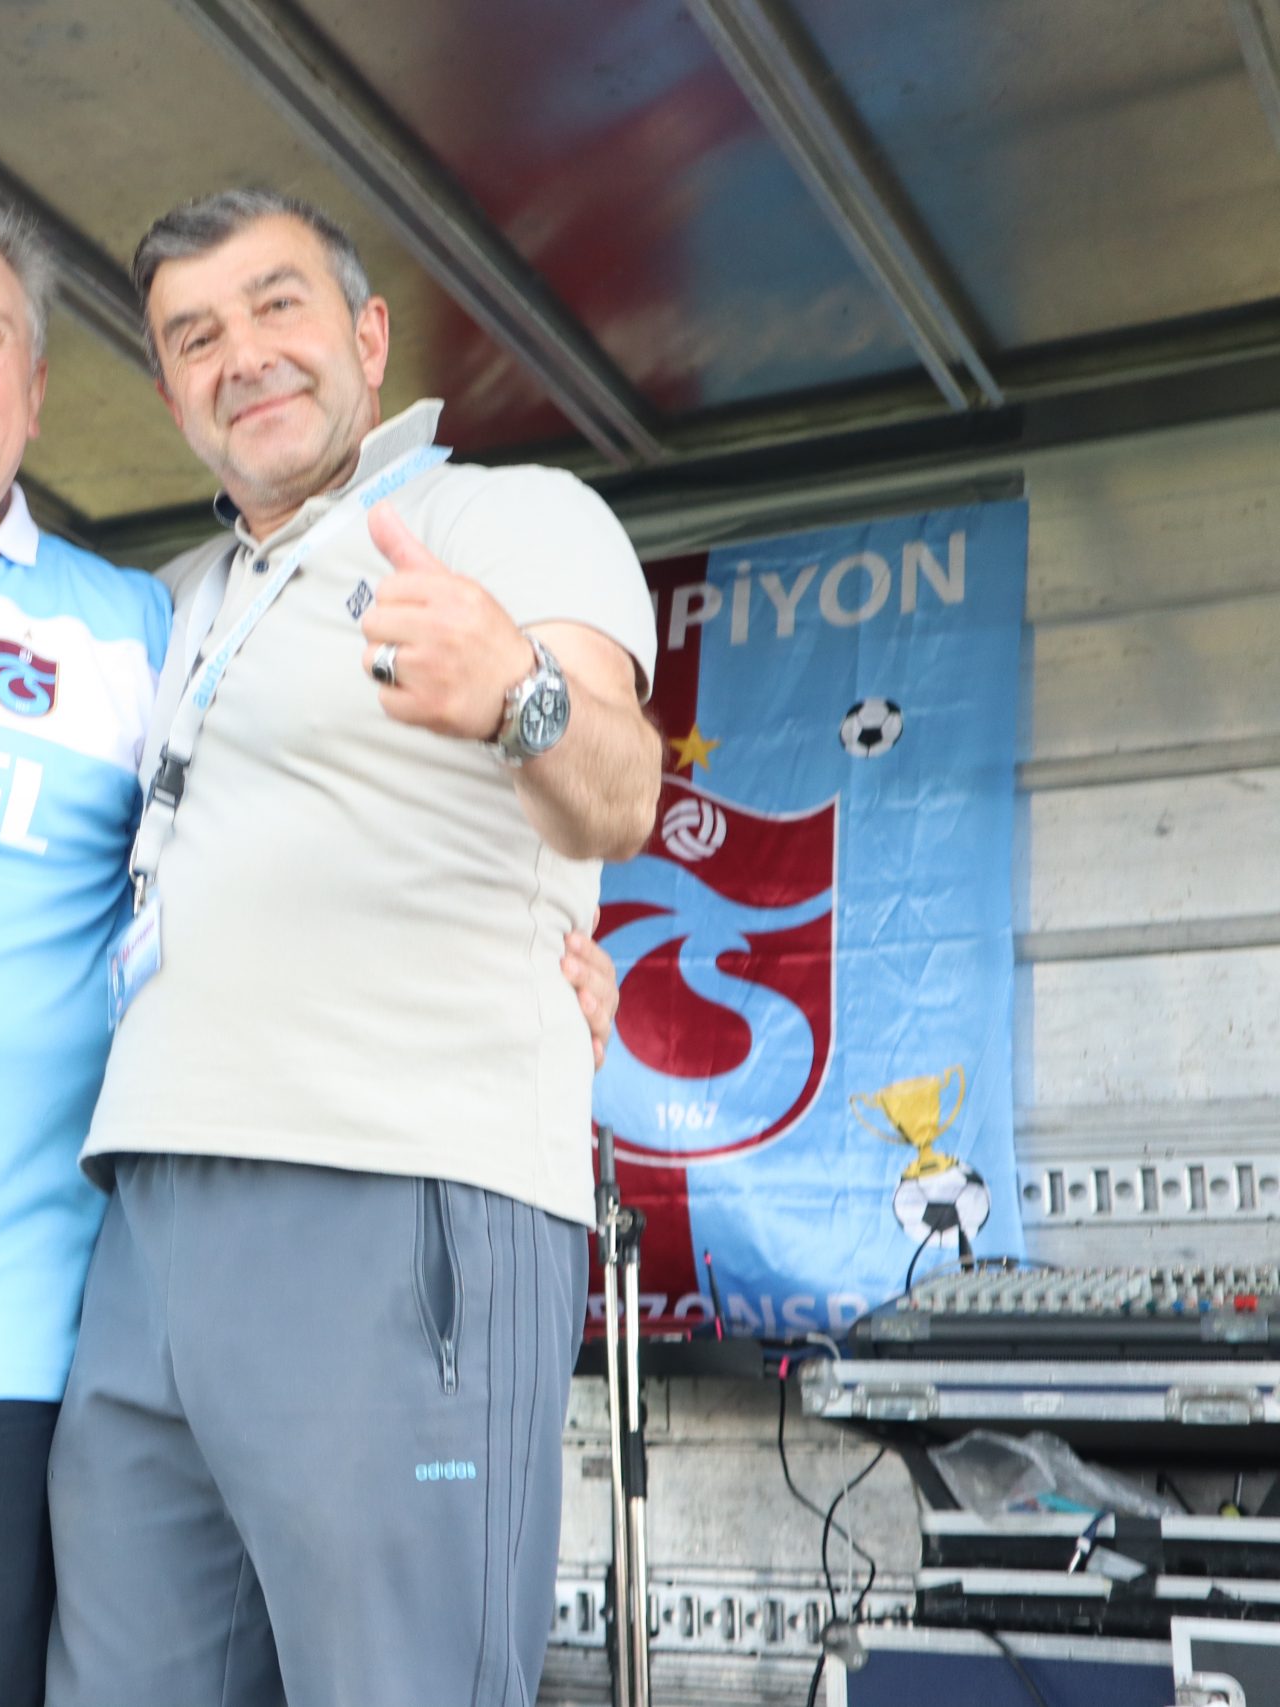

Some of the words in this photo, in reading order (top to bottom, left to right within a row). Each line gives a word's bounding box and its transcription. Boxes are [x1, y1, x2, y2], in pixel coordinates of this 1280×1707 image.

[651, 530, 966, 651] PİYON
[656, 1102, 719, 1132] 1967
[415, 1459, 476, 1481] adidas
